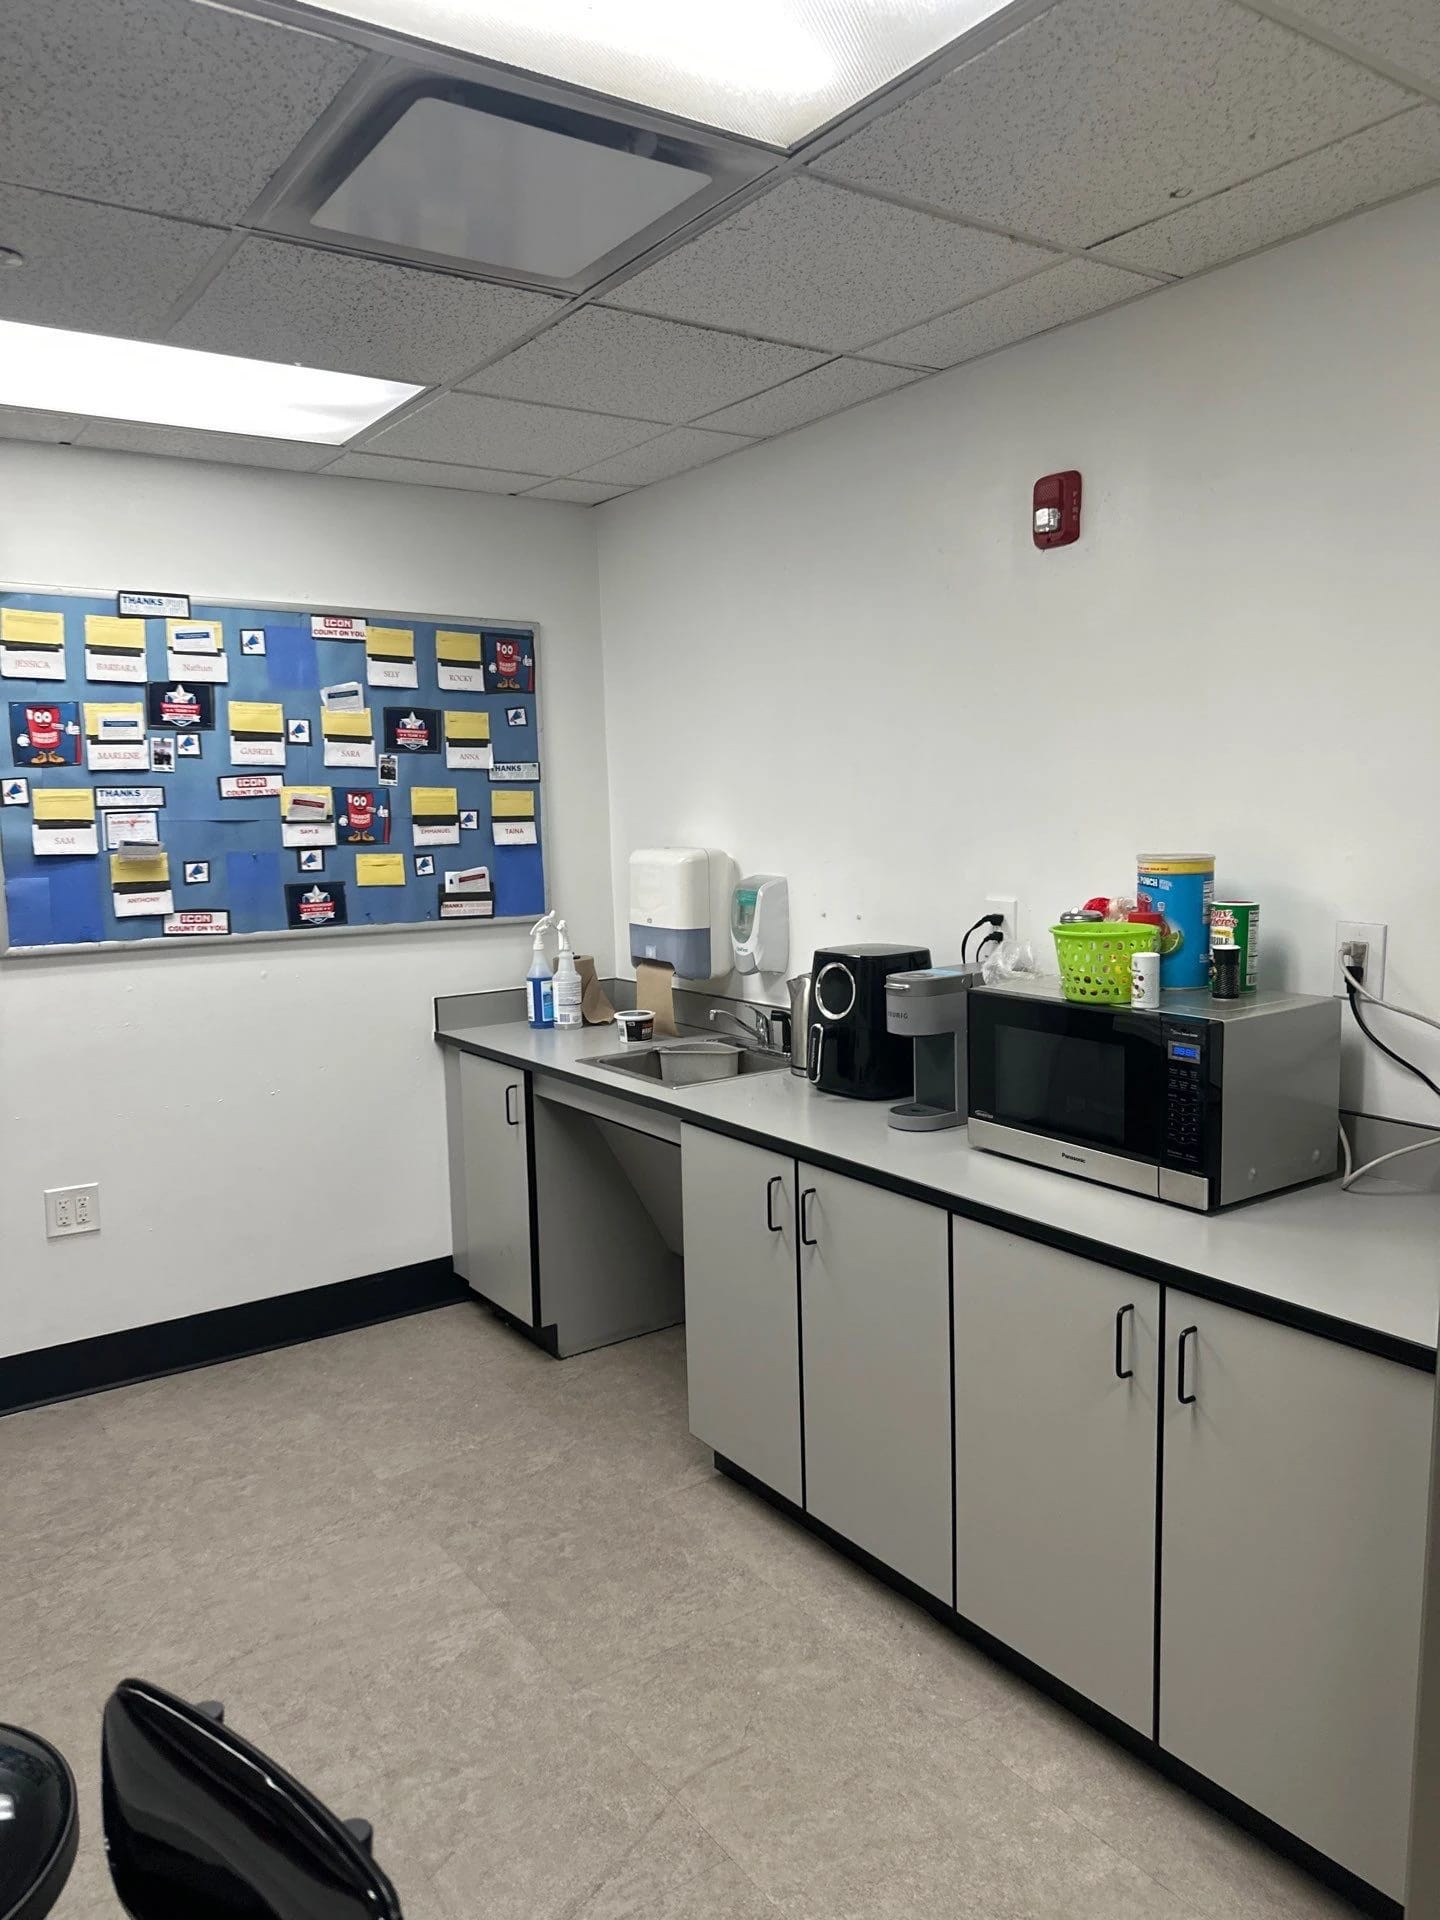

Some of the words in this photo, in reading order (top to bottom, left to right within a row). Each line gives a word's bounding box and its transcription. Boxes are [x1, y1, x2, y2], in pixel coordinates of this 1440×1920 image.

[123, 596, 163, 606] THANKS
[314, 629, 338, 637] COUNT
[339, 629, 349, 637] ON
[16, 659, 50, 669] JESSICA
[449, 674, 473, 682] ROCKY
[341, 750, 361, 758] SARA
[459, 752, 480, 761] ANNA
[99, 789, 141, 797] THANKS
[54, 837, 76, 845] SAM
[127, 896, 160, 904] ANTHONY
[1061, 1152, 1086, 1164] Panasonic
